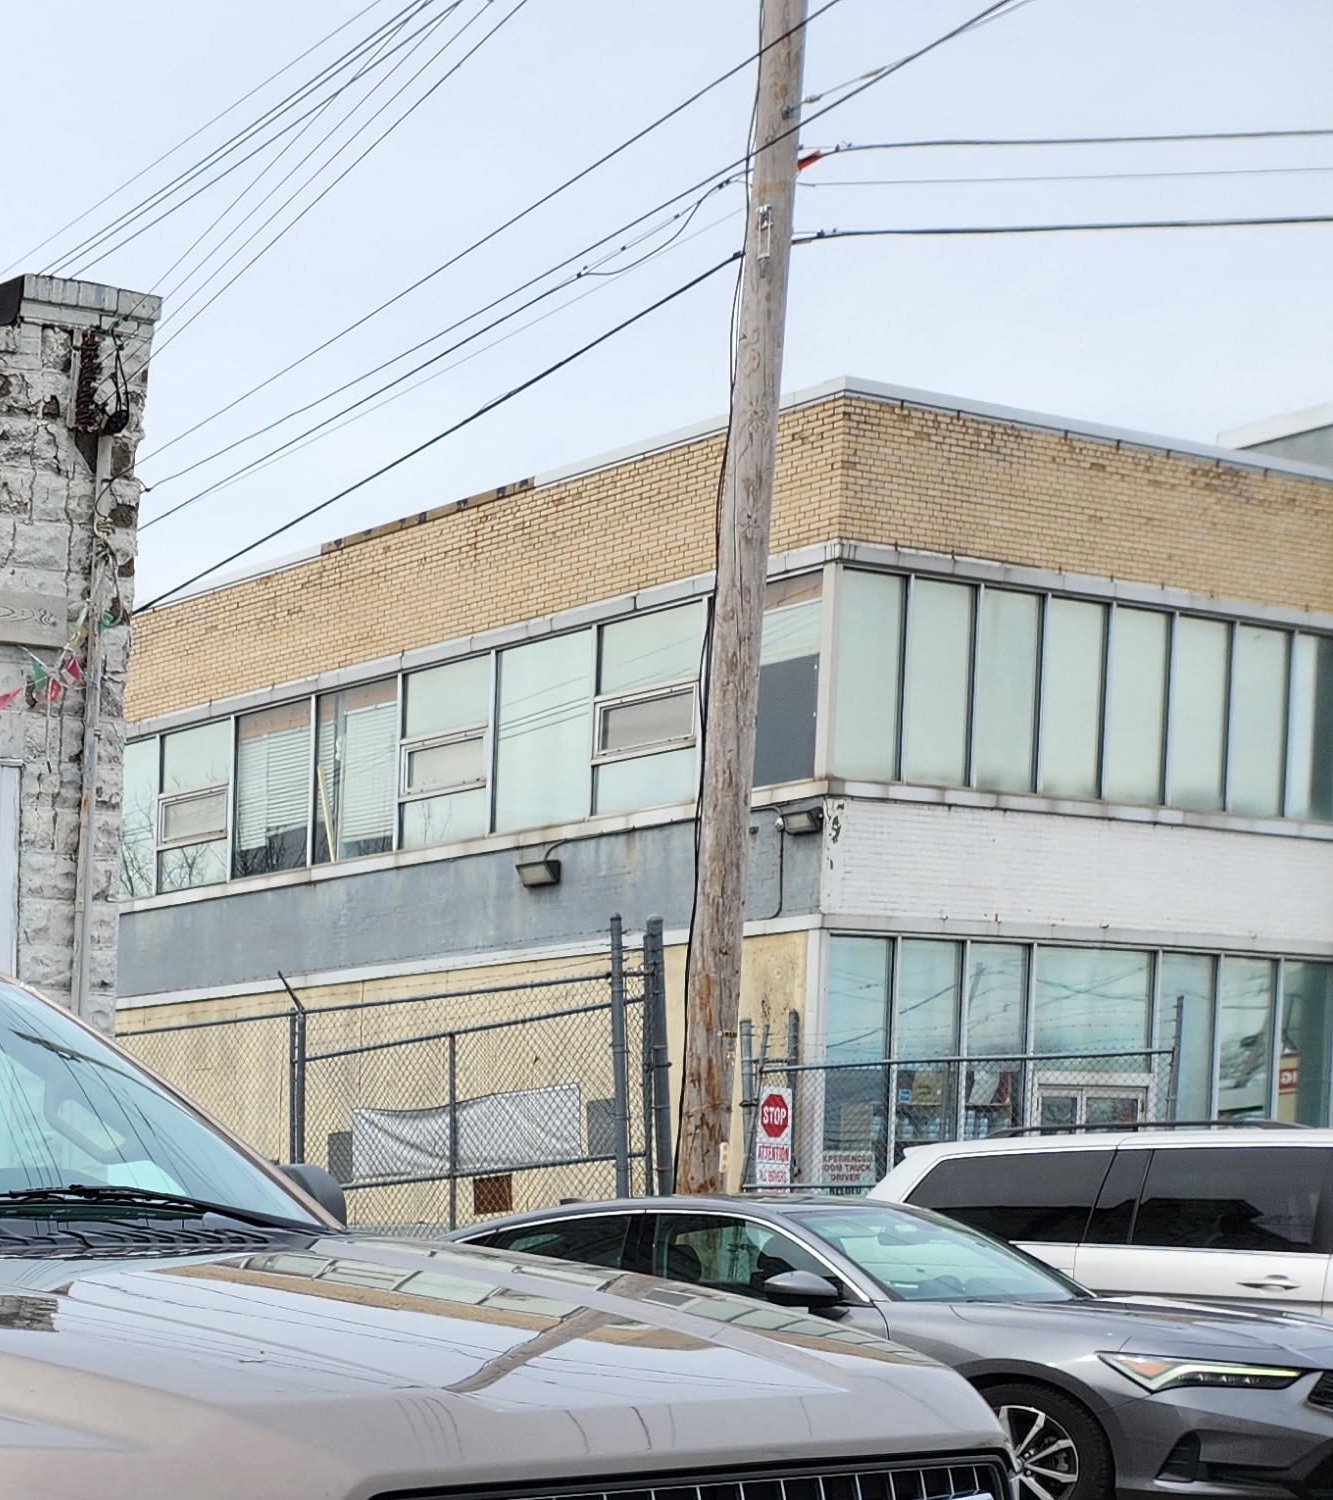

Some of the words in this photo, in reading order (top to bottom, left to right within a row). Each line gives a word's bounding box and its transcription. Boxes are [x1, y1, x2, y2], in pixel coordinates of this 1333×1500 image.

[762, 1105, 787, 1126] STOP
[758, 1144, 789, 1162] ATTENTION
[823, 1154, 872, 1163] XPERIENCED
[823, 1164, 843, 1172] OOM
[844, 1164, 871, 1173] TRUCK
[830, 1174, 860, 1182] DRIVER
